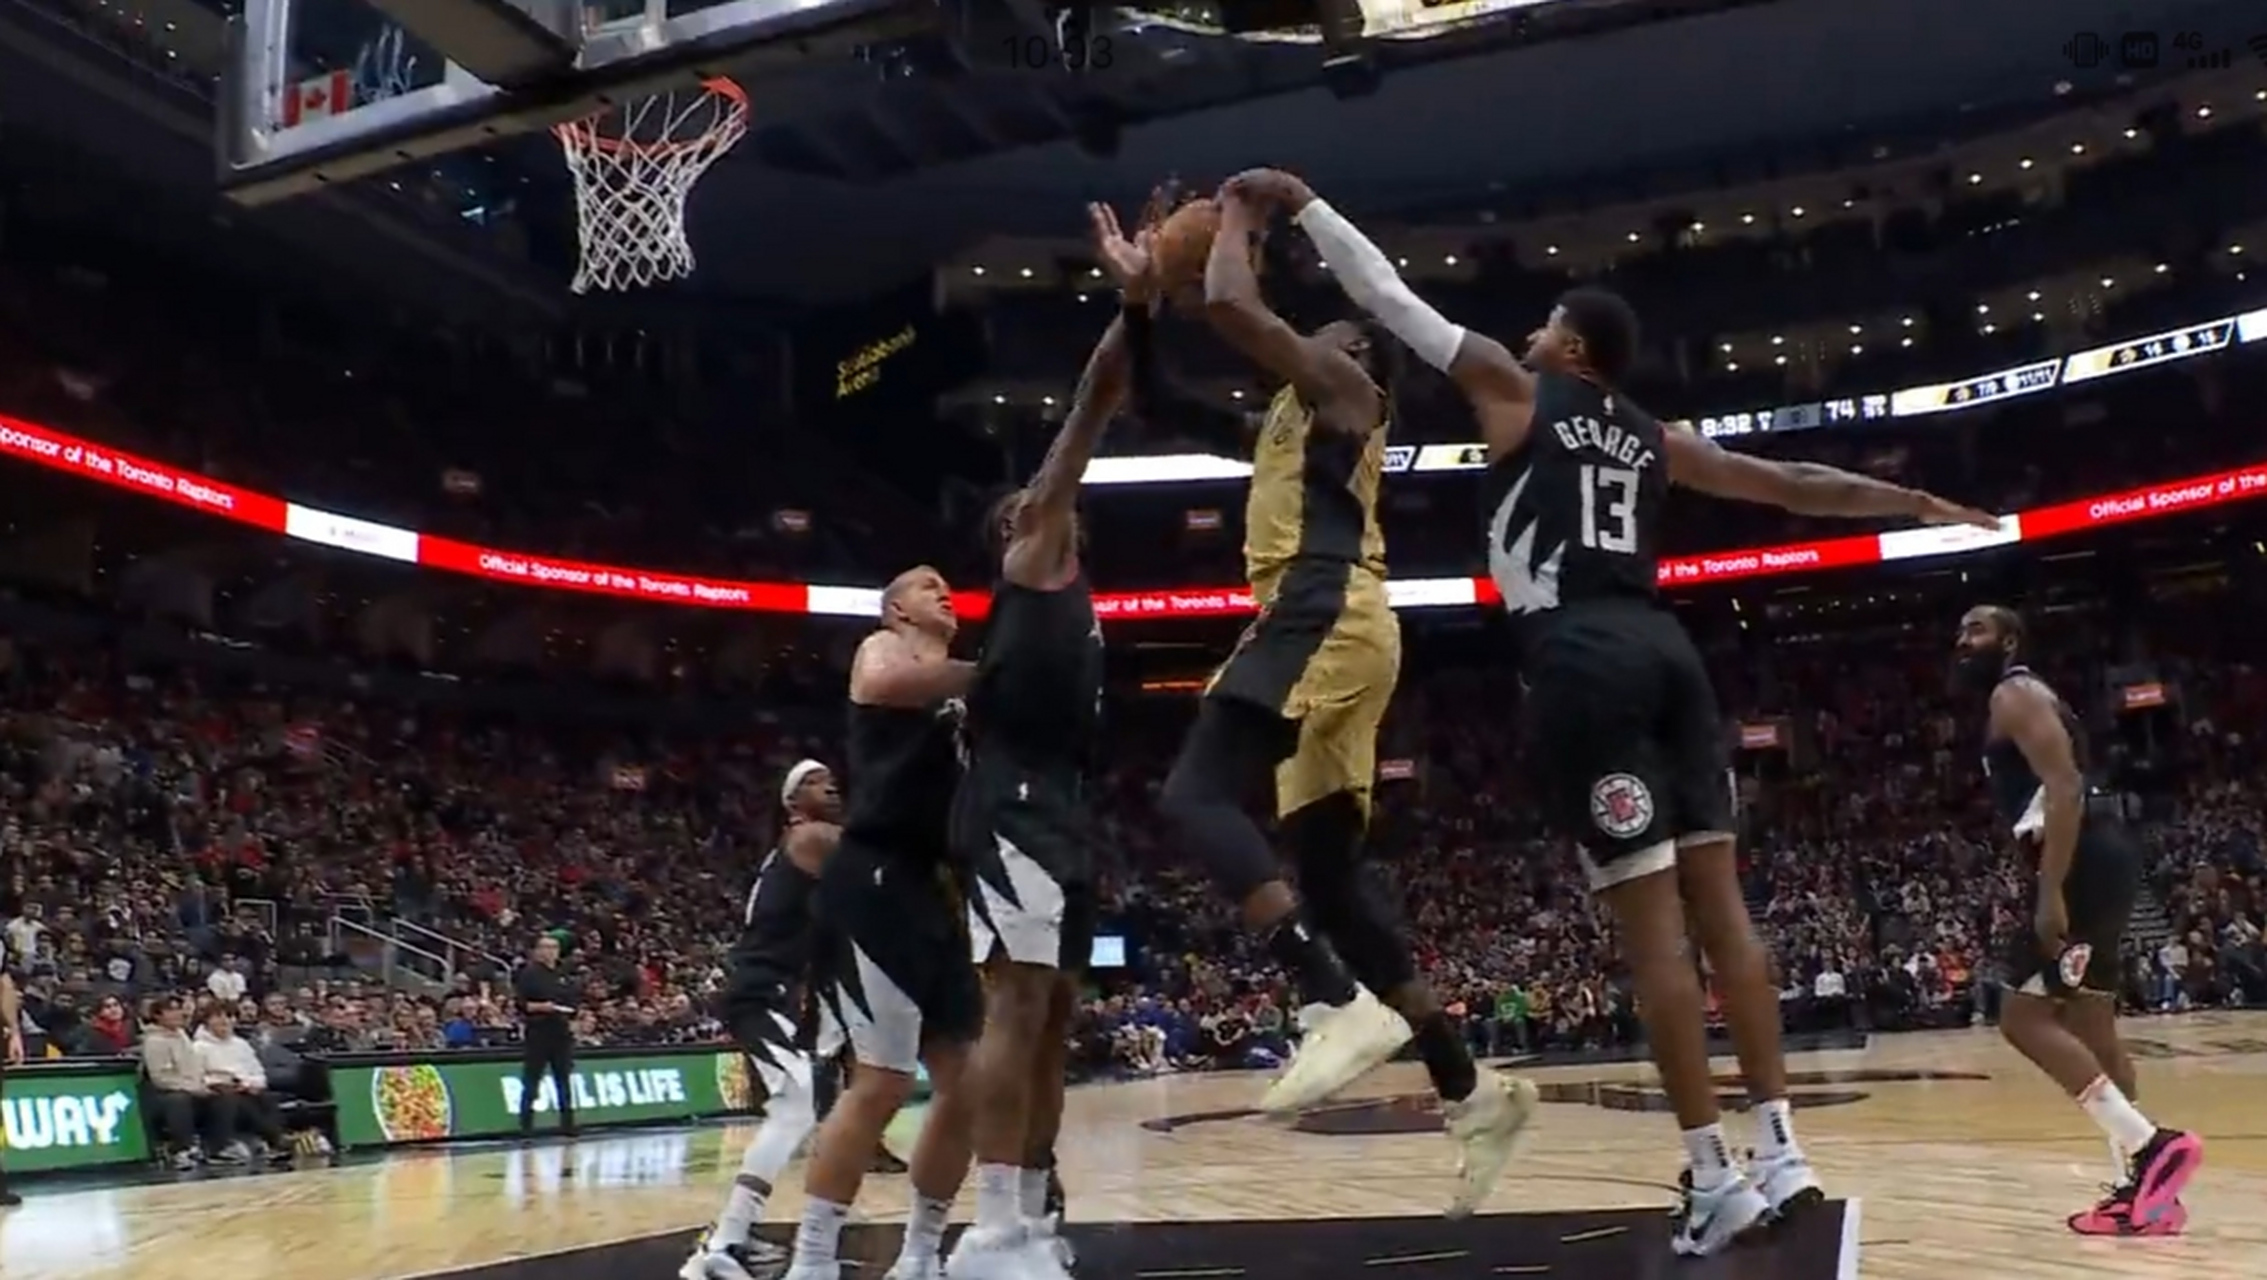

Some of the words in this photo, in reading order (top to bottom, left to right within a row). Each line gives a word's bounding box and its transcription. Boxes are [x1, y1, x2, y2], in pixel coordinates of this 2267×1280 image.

[1825, 398, 1856, 421] 74
[0, 426, 60, 457] ponsor
[63, 446, 82, 464] of
[85, 451, 112, 473] the
[115, 456, 174, 491] Toronto
[176, 478, 233, 509] Raptors
[1553, 415, 1655, 473] GEORGE
[1580, 464, 1639, 555] 13
[2089, 495, 2145, 519] Official
[2148, 483, 2213, 509] Sponsor
[2218, 477, 2235, 493] of
[2239, 472, 2267, 490] the
[479, 554, 528, 576] Official
[530, 562, 590, 584] Sponsor
[593, 572, 608, 586] of
[611, 574, 635, 590] the
[639, 576, 690, 597] Toronto
[693, 583, 750, 603] Raptors
[1674, 562, 1699, 578] the
[1702, 556, 1759, 573] Toronto
[1761, 550, 1819, 568] Raptors
[1141, 597, 1165, 611] the
[1170, 594, 1226, 610] Toronto
[593, 1071, 628, 1108] IS
[624, 1067, 687, 1105] LIFE
[2, 1090, 131, 1150] WAY
